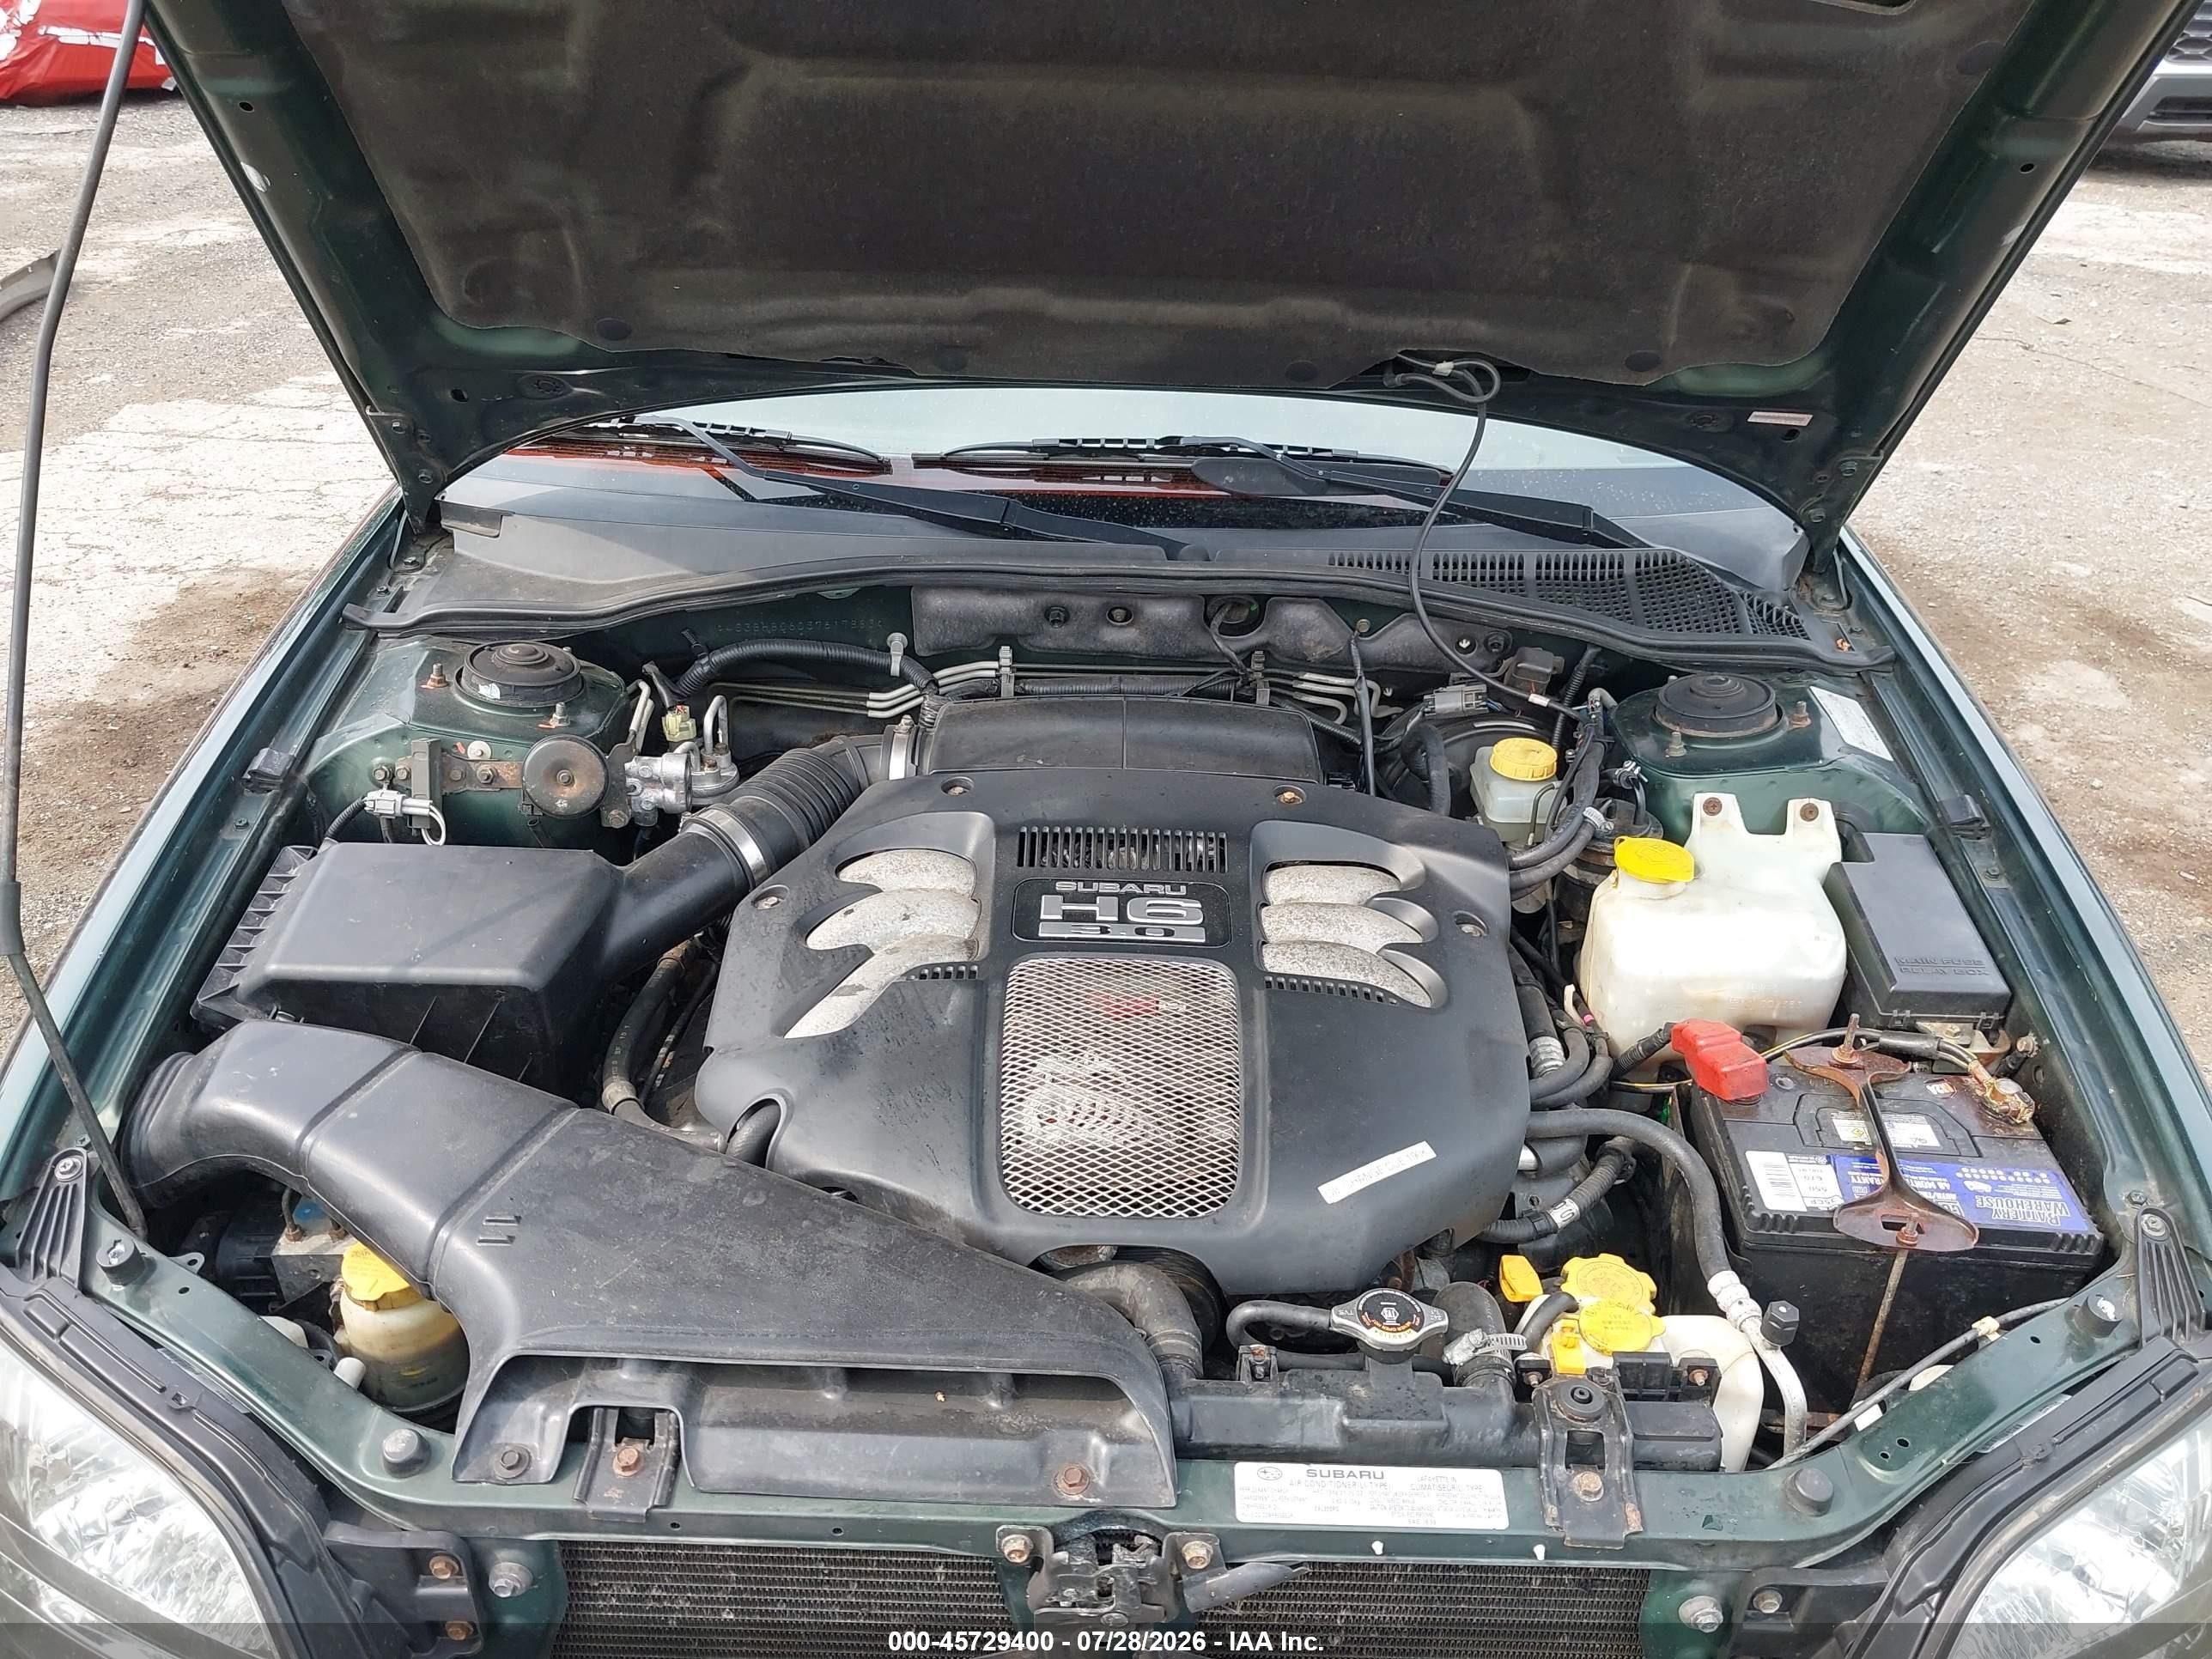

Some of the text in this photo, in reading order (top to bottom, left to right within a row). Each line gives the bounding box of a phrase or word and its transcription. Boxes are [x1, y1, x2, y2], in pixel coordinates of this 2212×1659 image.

[1054, 881, 1187, 896] SUBARU
[1040, 895, 1204, 925] H6
[1905, 1178, 1935, 1189] MONT
[1974, 1194, 2071, 1217] WAREHOUSE
[1990, 1208, 2062, 1226] BATTERY
[1306, 1468, 1384, 1480] SUBARU
